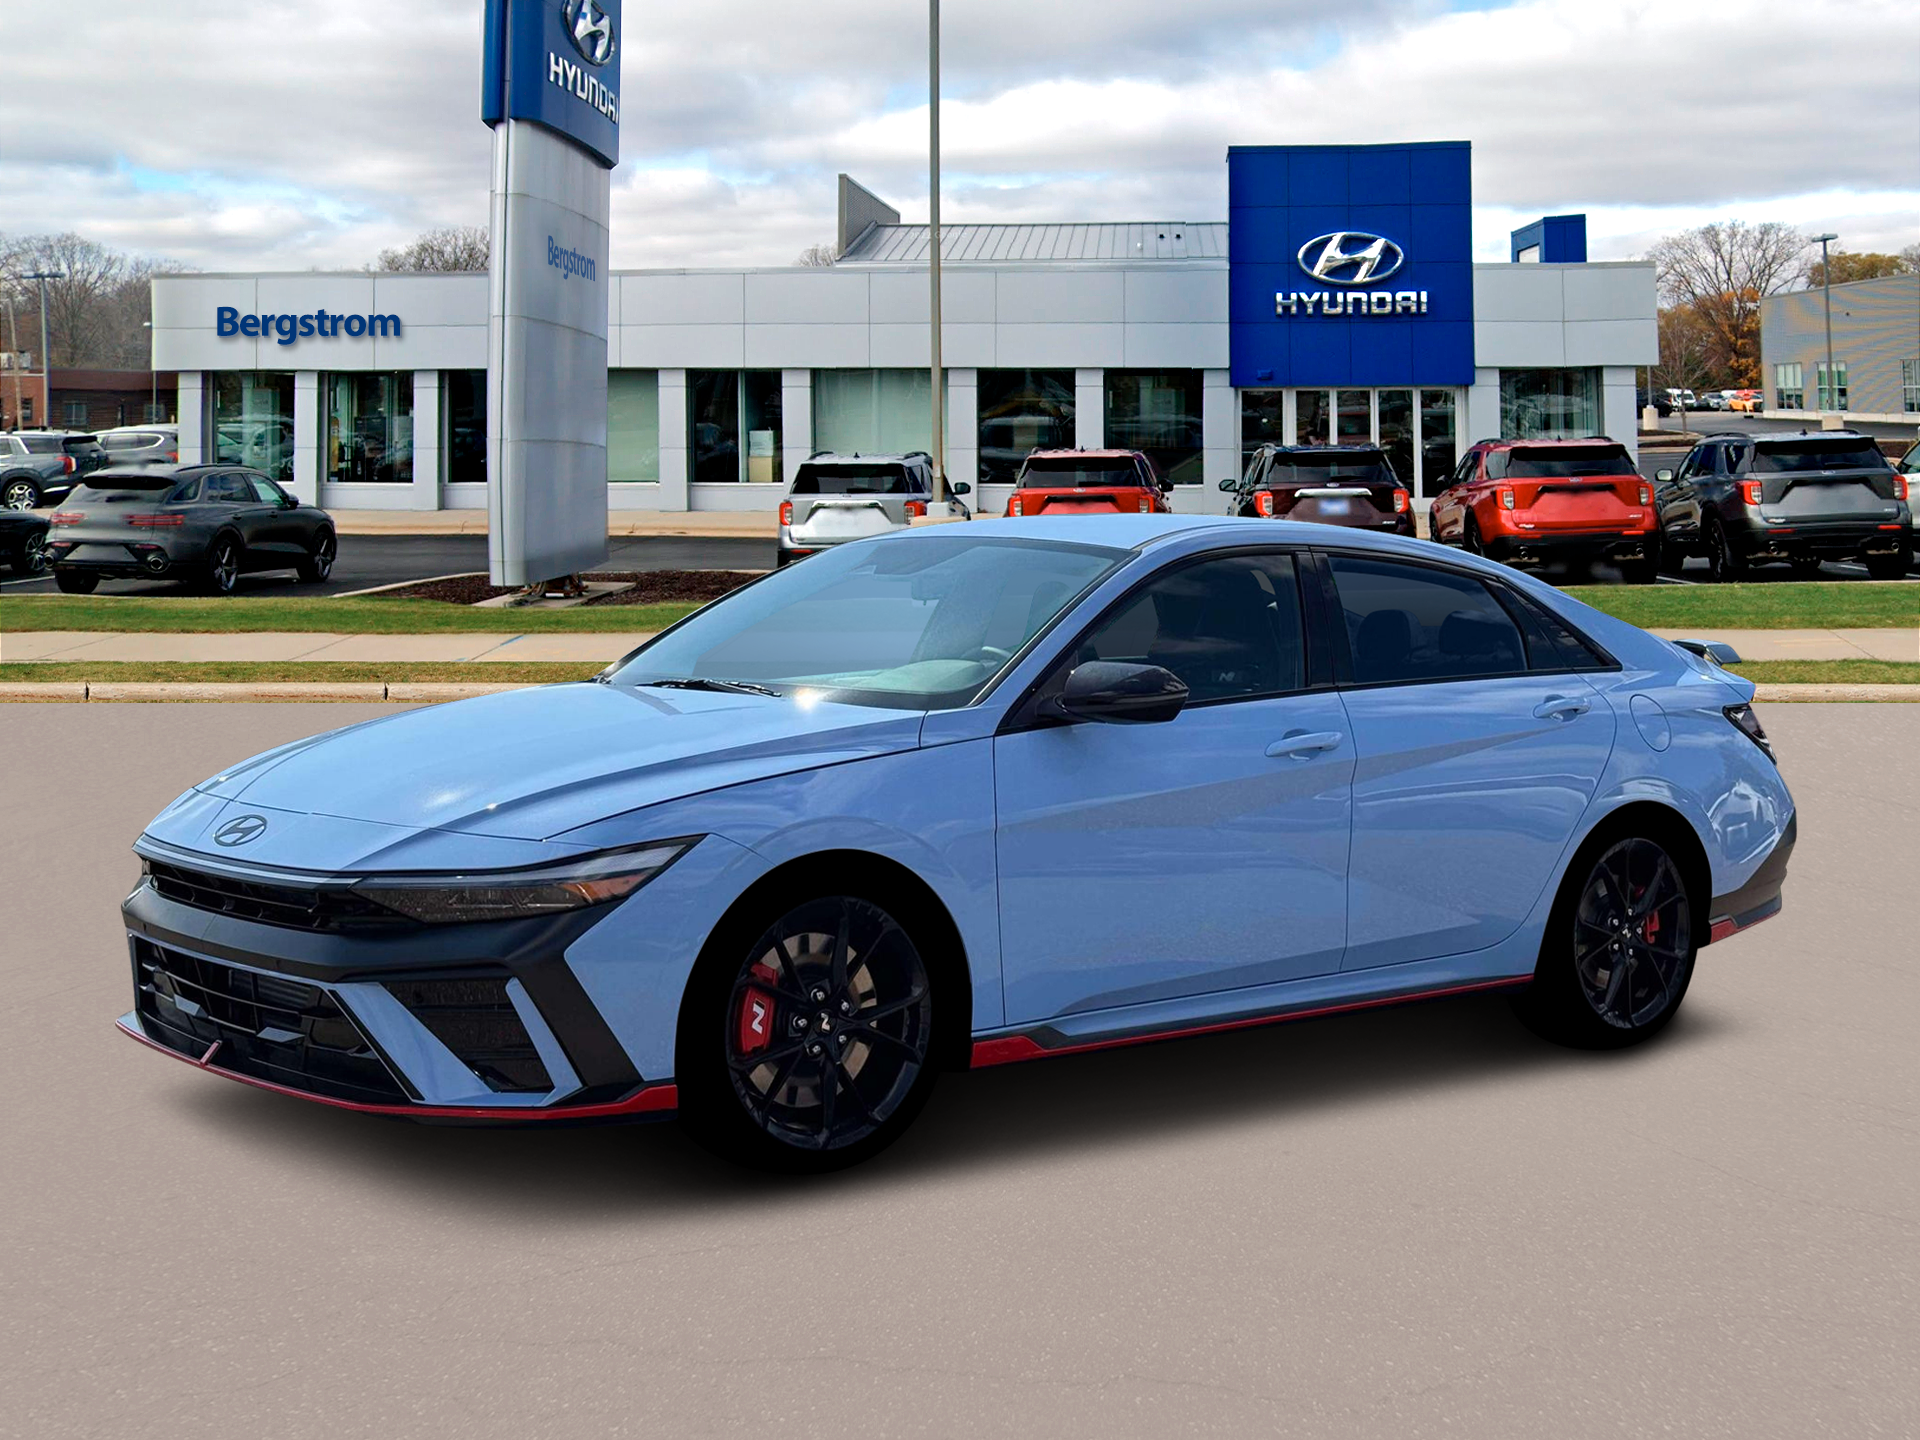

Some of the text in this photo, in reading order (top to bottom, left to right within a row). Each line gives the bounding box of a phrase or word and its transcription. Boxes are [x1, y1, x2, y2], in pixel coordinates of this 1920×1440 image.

[547, 234, 596, 282] Bergstrom
[1275, 290, 1428, 315] HYUNDAI
[216, 306, 401, 346] Bergstrom
